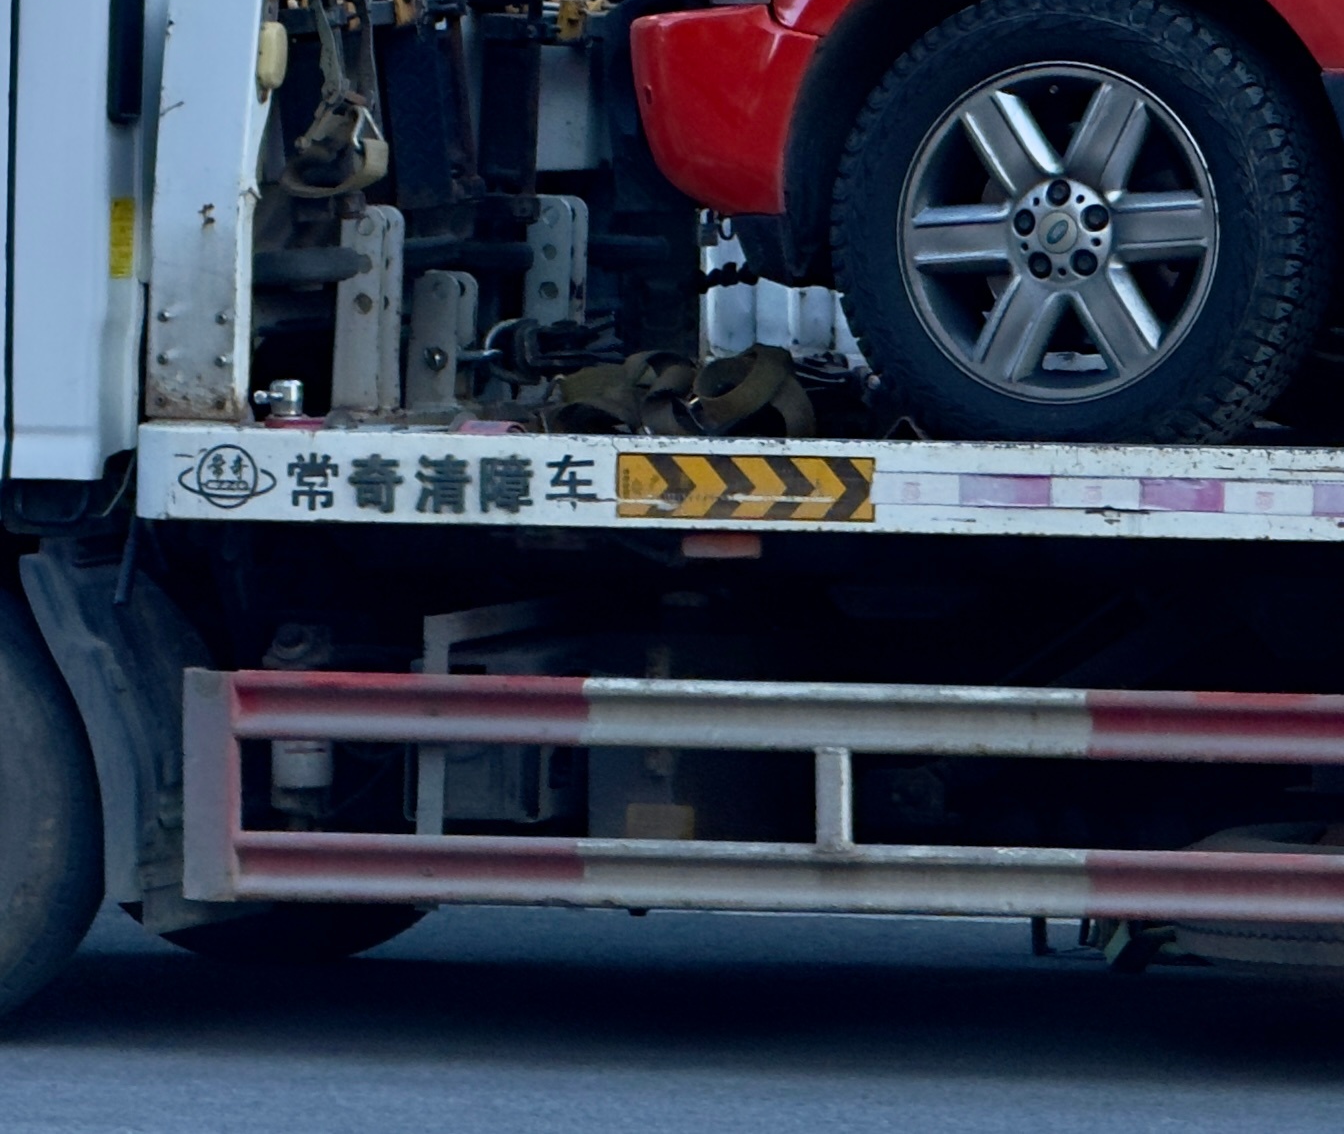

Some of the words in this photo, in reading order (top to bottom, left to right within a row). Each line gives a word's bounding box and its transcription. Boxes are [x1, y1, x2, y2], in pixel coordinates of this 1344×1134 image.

[287, 452, 597, 513] 常奇清障车
